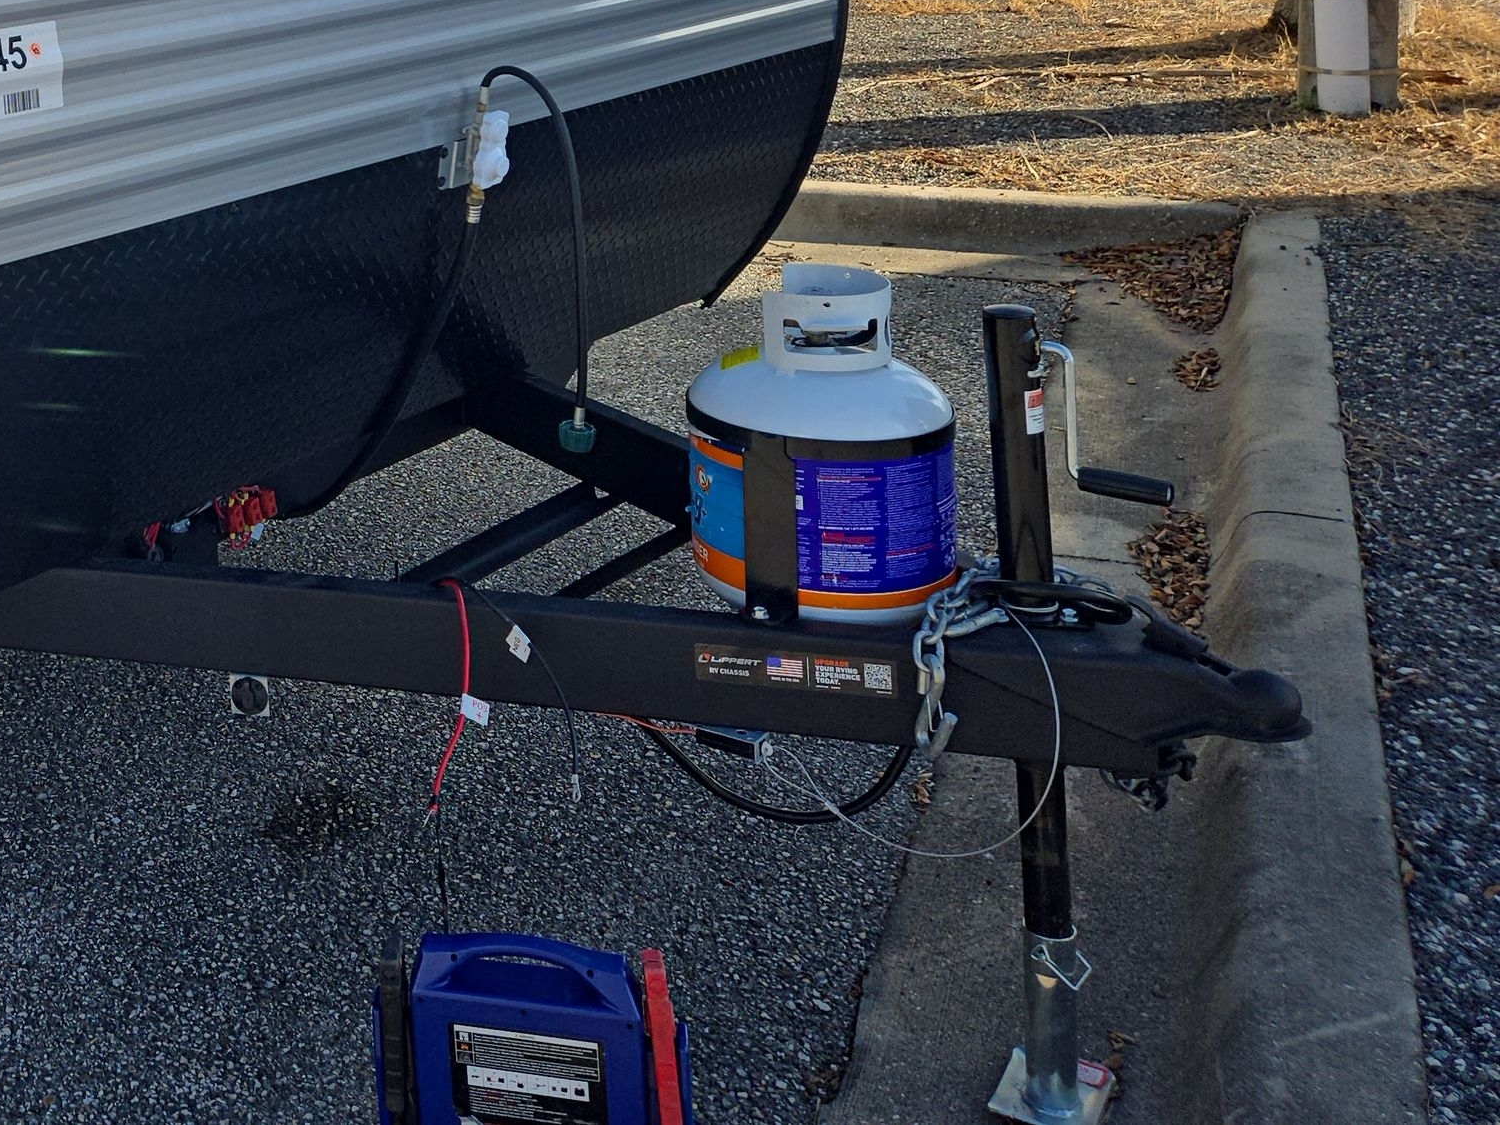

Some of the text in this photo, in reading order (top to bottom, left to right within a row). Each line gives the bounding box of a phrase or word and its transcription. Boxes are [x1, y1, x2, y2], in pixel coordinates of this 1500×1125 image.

[711, 655, 762, 666] LIPPERT
[814, 659, 849, 668] UPGRADE
[709, 666, 750, 677] RV CHASSIS
[815, 665, 834, 673] YOUR
[815, 672, 861, 682] EXPERIENCE
